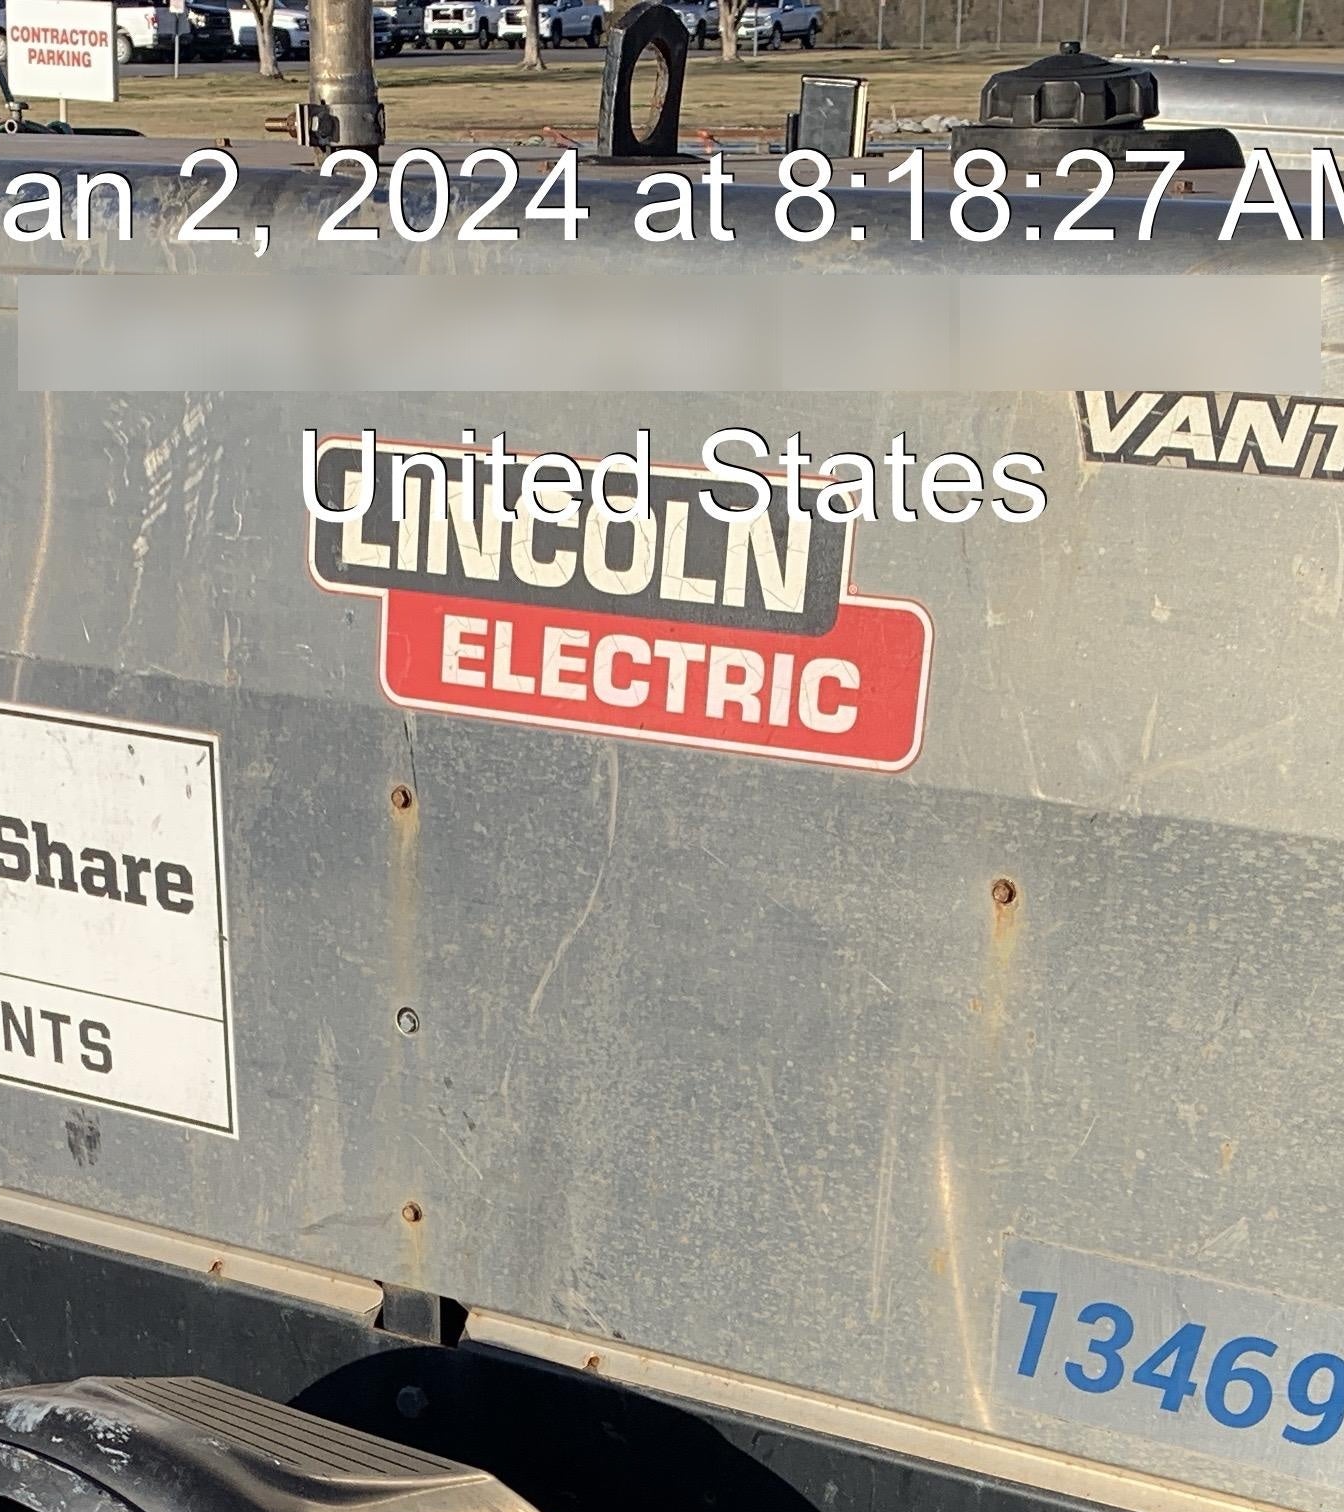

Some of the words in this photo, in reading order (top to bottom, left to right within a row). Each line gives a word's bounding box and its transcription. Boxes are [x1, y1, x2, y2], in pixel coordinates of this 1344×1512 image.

[10, 25, 109, 48] CONTRACTOR
[27, 47, 92, 68] PARKING
[341, 470, 811, 615] LINCOLN
[440, 613, 861, 735] ELECTRIC
